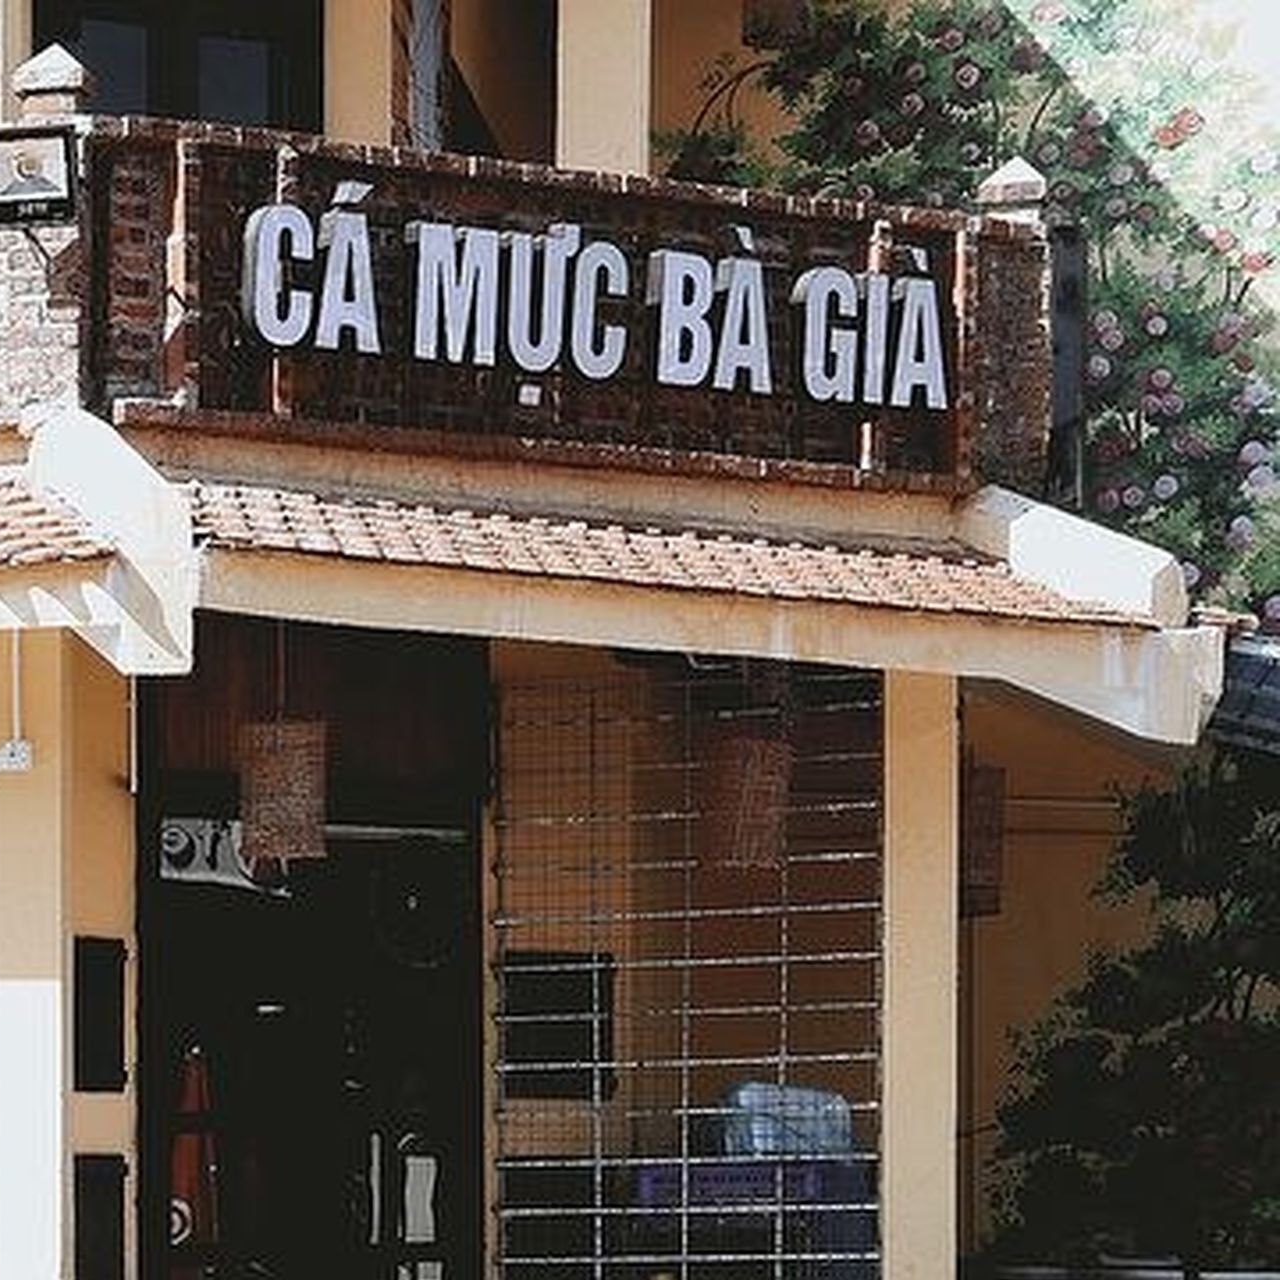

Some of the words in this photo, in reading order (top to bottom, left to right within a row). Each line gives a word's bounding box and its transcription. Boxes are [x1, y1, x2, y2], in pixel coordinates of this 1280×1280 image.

[244, 181, 381, 354] CÁ
[404, 221, 628, 405] MỰC
[646, 225, 772, 394] BÀ
[790, 245, 947, 410] GIÀ
